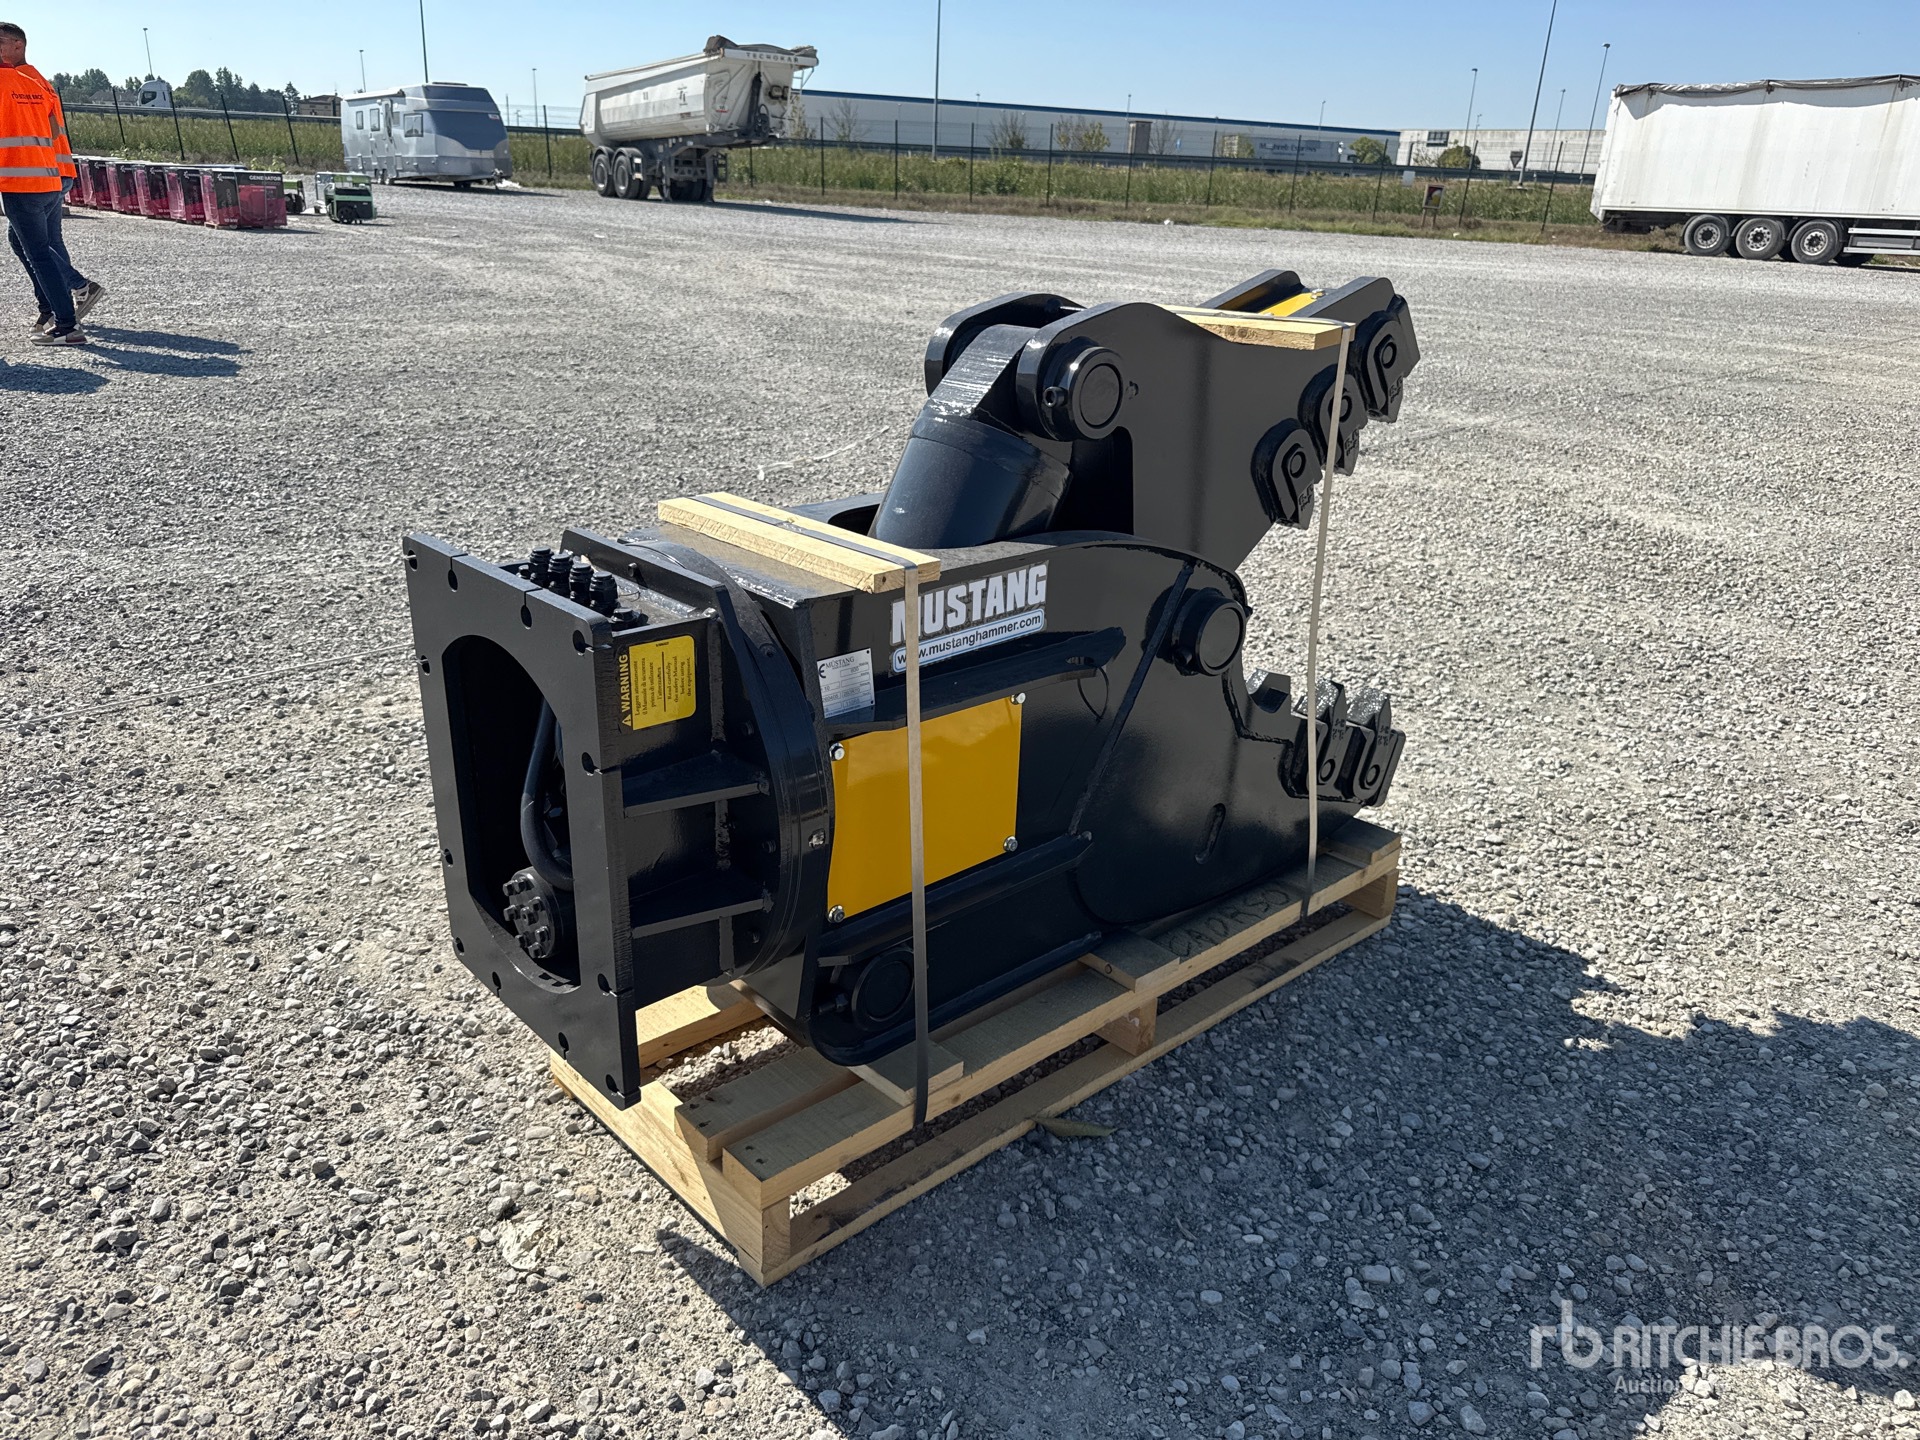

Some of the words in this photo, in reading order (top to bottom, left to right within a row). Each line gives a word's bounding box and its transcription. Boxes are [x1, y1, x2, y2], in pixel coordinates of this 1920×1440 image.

[892, 564, 1048, 645] MUSTANG
[897, 614, 1041, 664] ww.mustanghammer.com
[618, 654, 630, 712] WARNING
